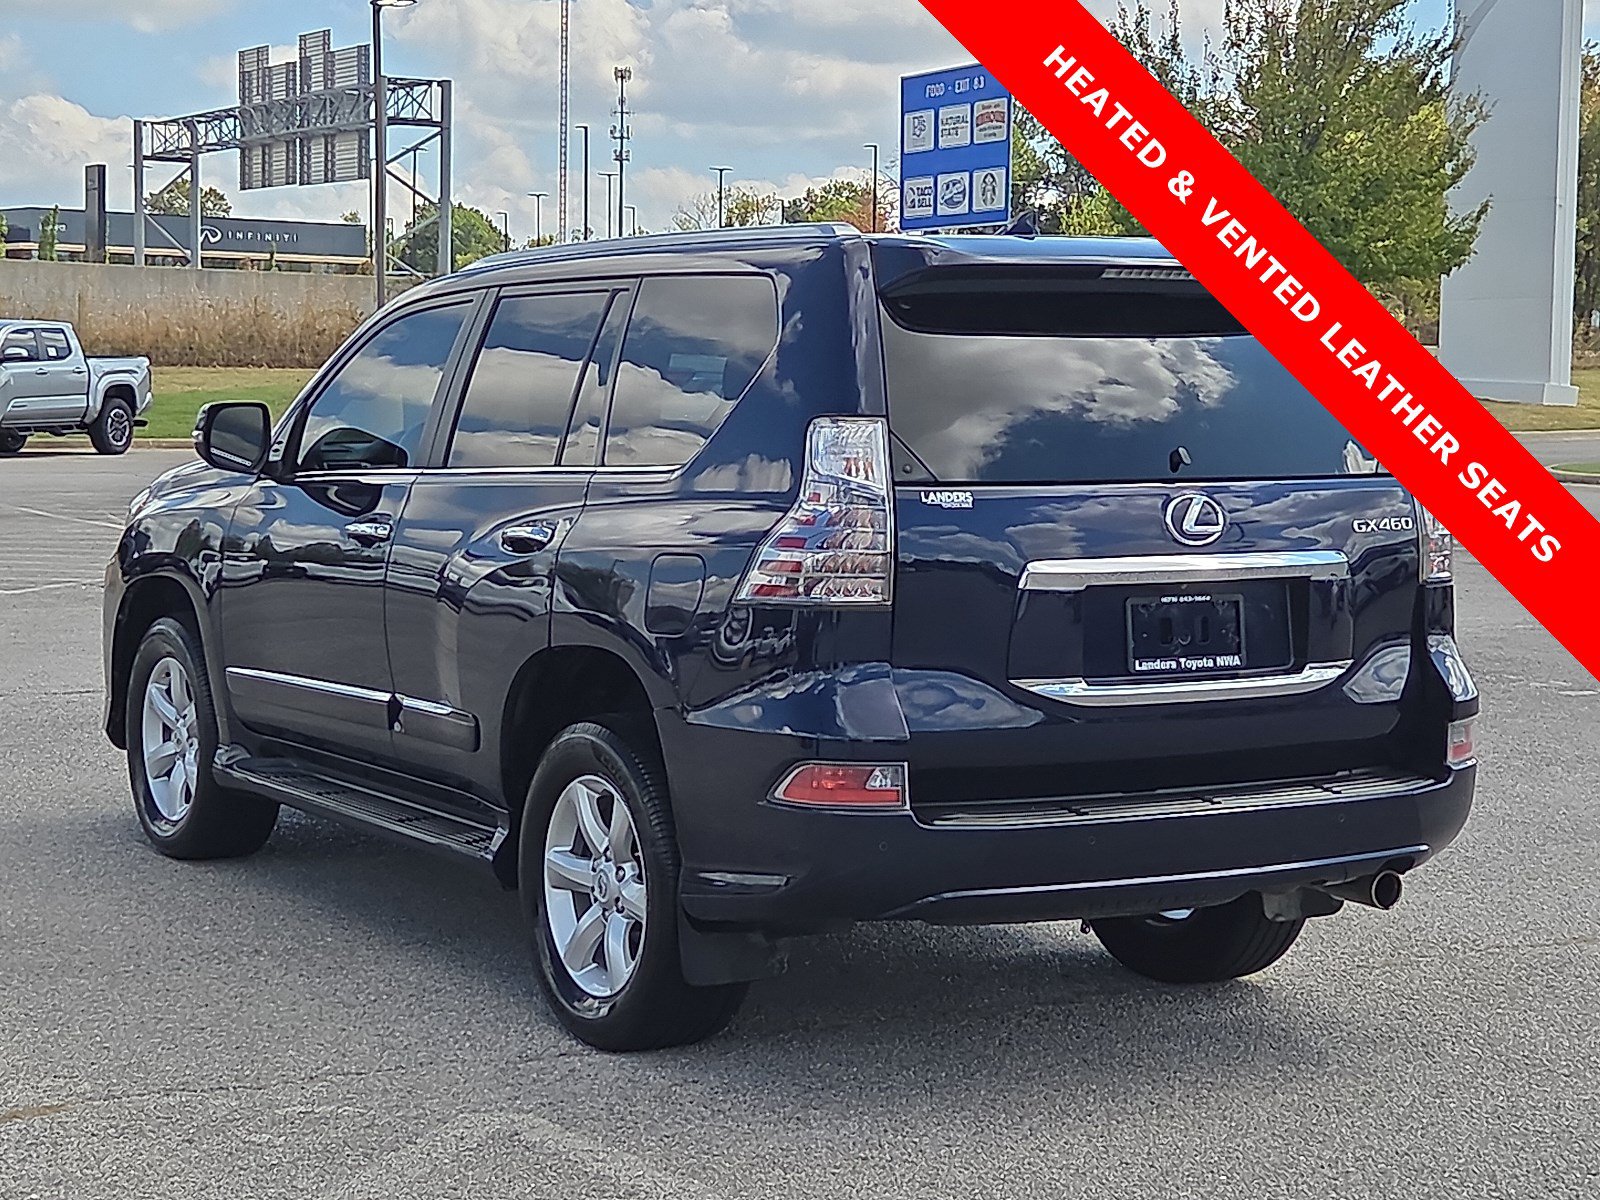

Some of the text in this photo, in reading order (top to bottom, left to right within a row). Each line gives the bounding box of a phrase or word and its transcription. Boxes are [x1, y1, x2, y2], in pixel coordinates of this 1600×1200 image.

[915, 186, 933, 196] TACO
[917, 197, 933, 208] BELL
[227, 230, 298, 243] INFINITI
[920, 491, 973, 504] LANDERS
[1352, 517, 1413, 533] GX460
[1135, 655, 1241, 671] Landers Toyota NWA
